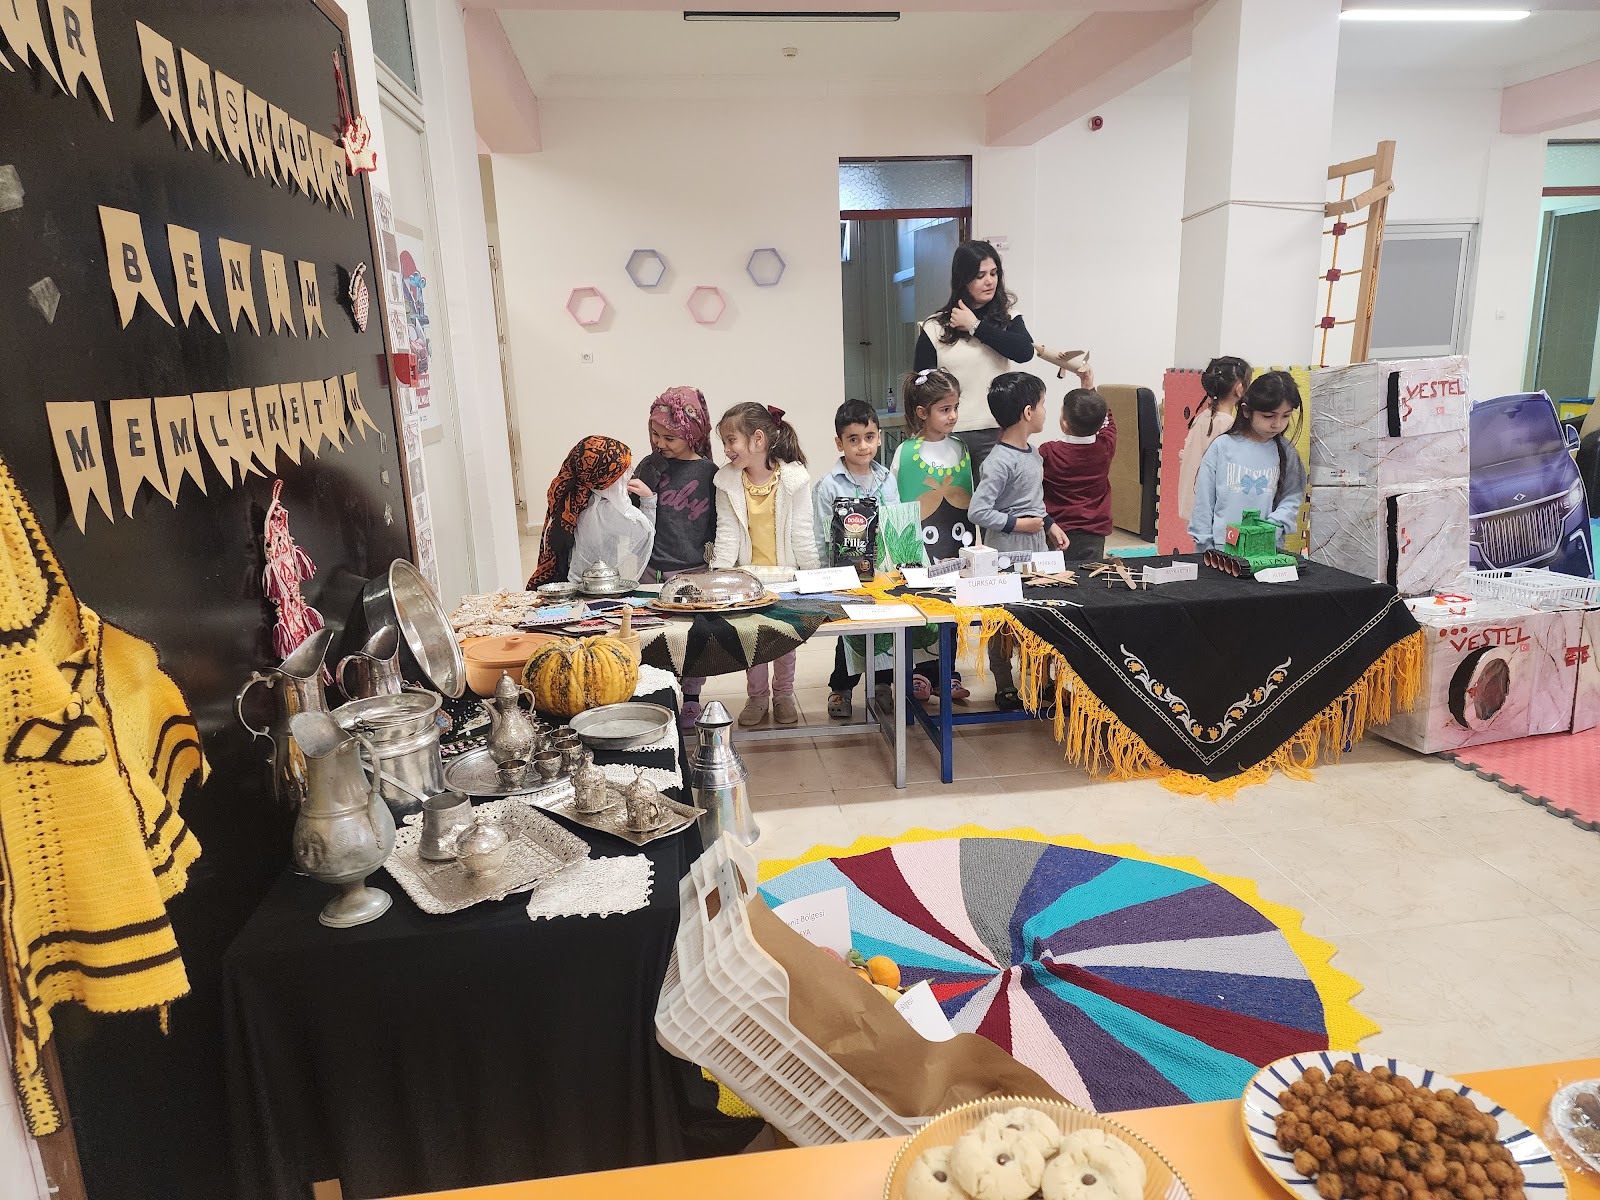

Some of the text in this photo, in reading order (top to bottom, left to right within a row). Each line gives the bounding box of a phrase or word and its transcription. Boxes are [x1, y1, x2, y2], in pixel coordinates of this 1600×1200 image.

[155, 56, 345, 187] BAŞKADIR
[122, 241, 316, 308] BENİM
[1405, 378, 1466, 400] VESTEL
[65, 387, 361, 473] MEMLEKETİM
[844, 536, 867, 548] Filiz
[1449, 626, 1531, 652] VESTEL
[800, 910, 825, 923] Bölgesi
